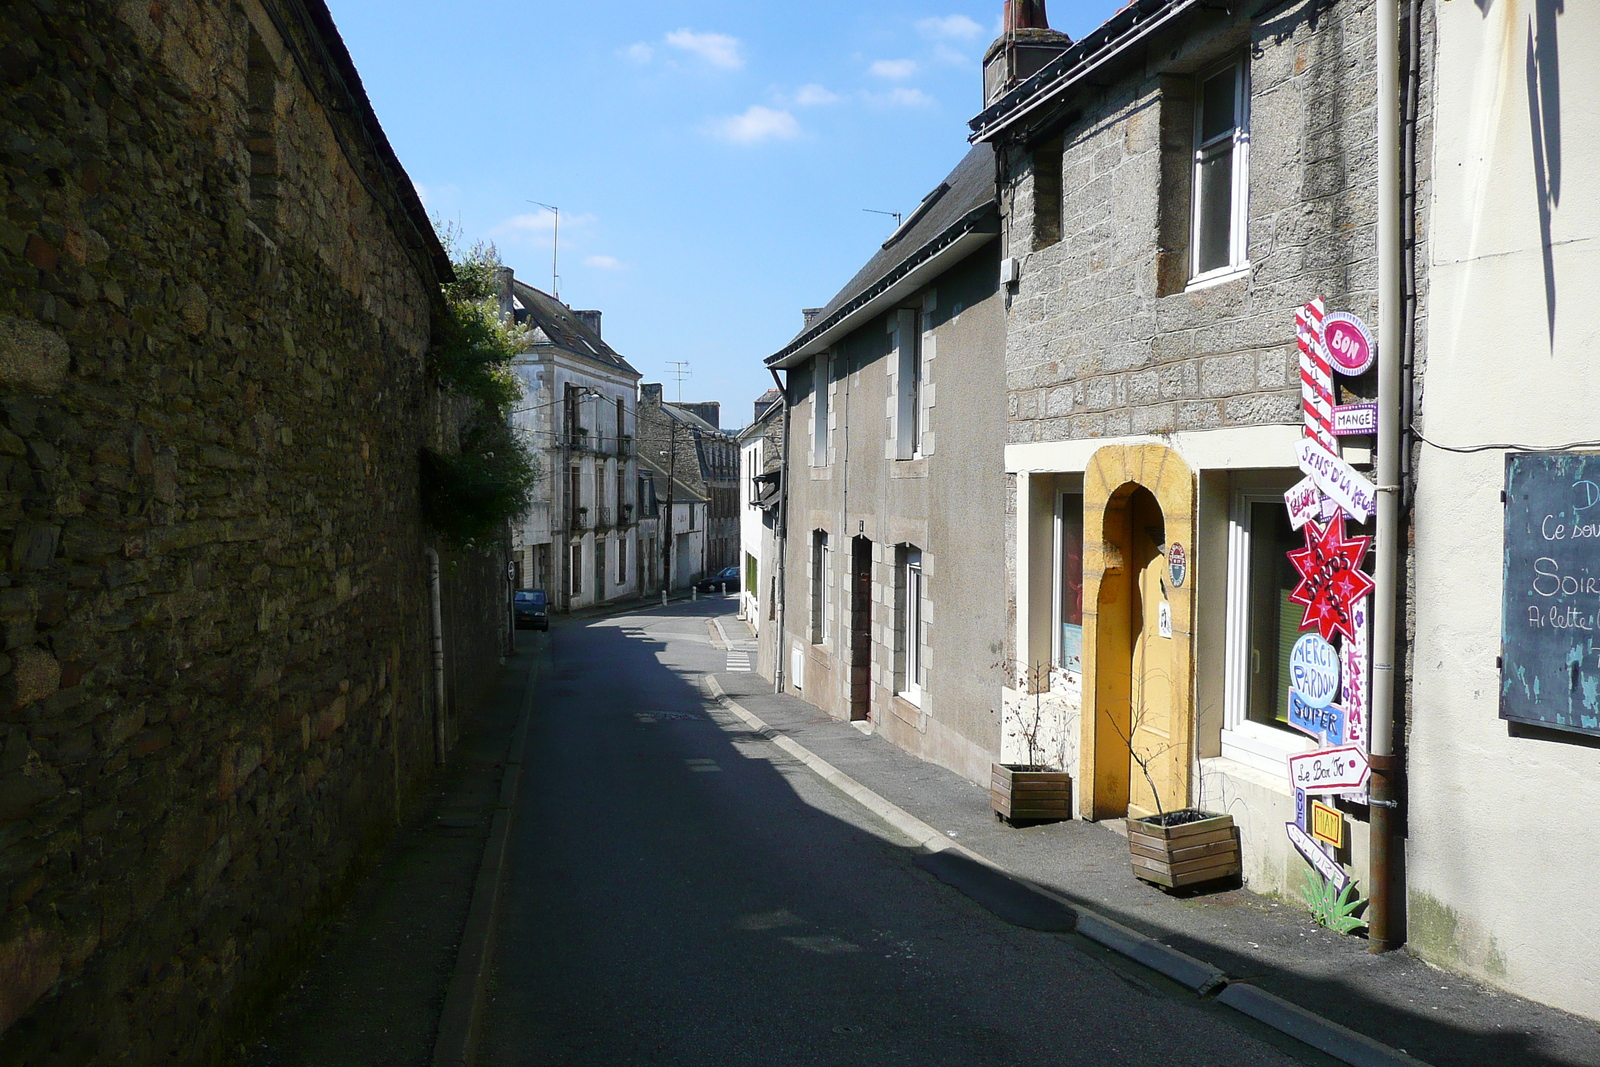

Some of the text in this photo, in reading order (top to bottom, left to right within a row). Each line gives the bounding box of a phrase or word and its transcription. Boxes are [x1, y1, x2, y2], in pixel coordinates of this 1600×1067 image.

[1331, 329, 1360, 361] BON
[1338, 410, 1371, 427] MANGÉ
[1542, 514, 1566, 540] Ce
[1528, 605, 1593, 631] Arlette
[1294, 665, 1334, 699] PARDON
[1293, 698, 1338, 735] SUPER
[1297, 763, 1310, 782] Le
